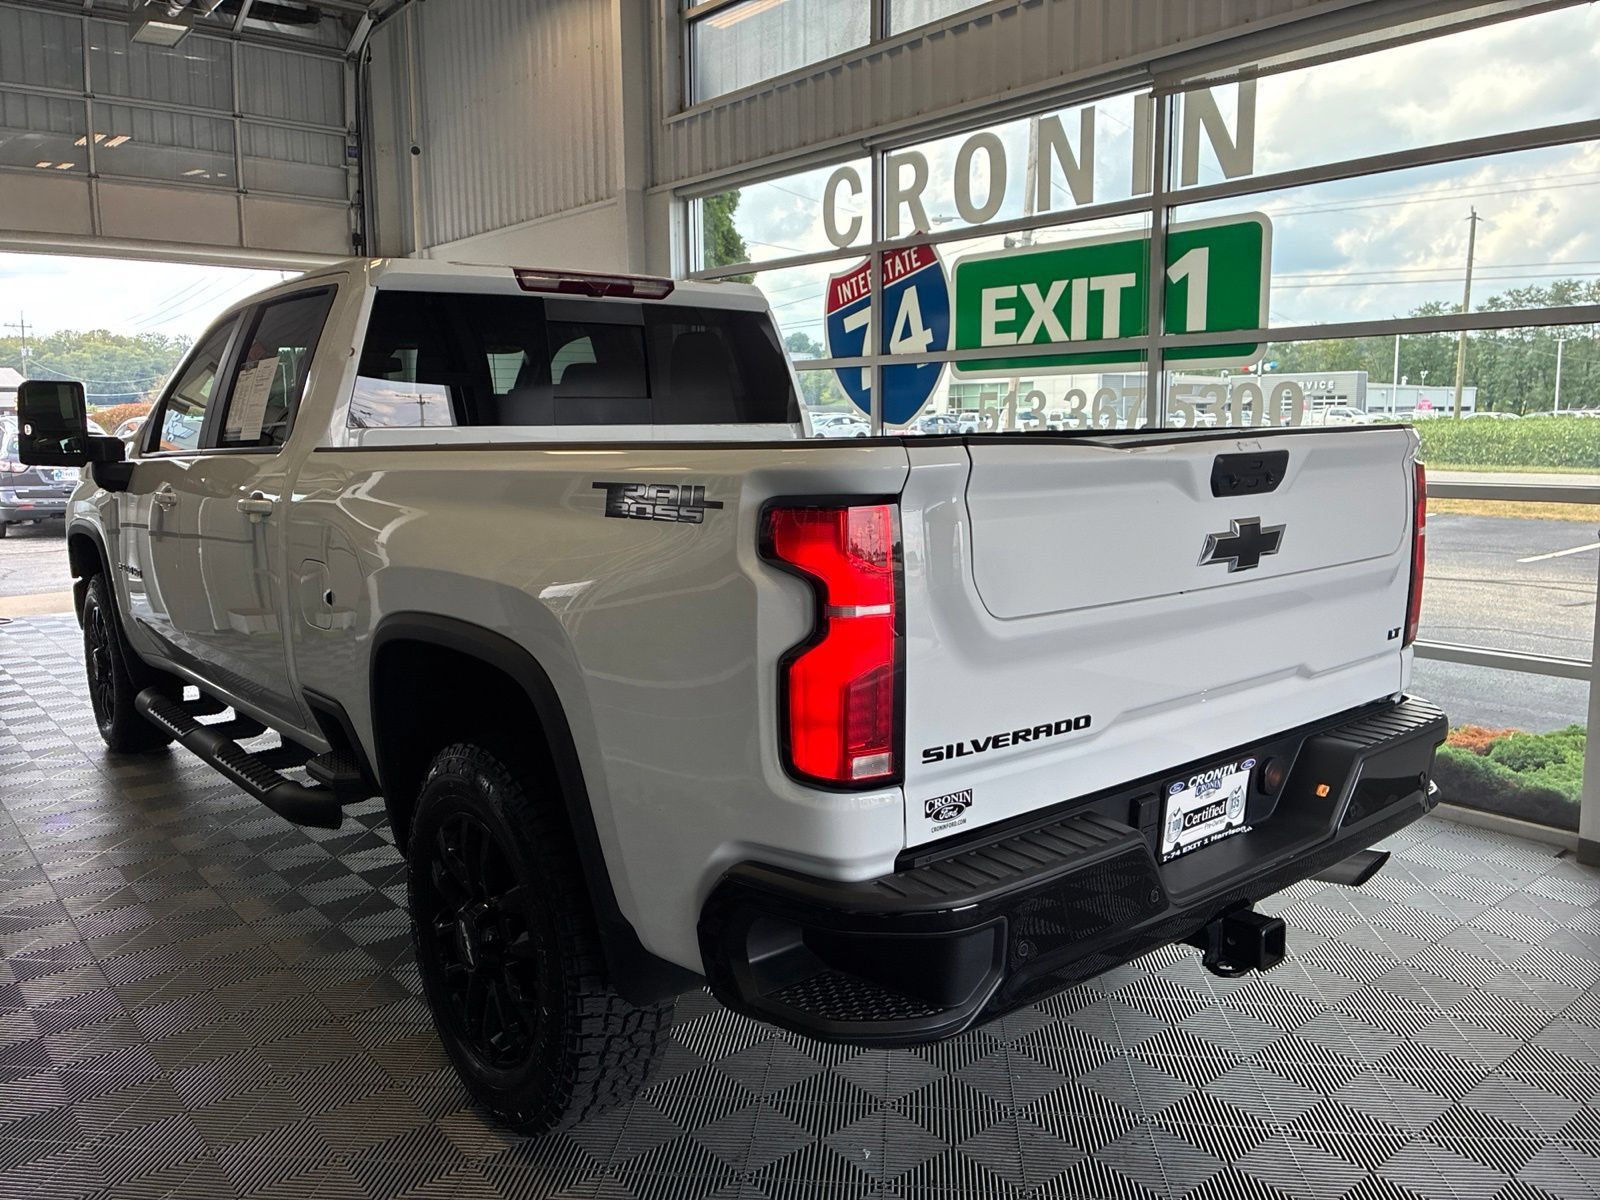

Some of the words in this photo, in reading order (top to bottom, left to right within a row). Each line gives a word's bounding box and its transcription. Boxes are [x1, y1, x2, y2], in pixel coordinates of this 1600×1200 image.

[823, 64, 1258, 248] CRONIN
[837, 246, 922, 305] INTETATE
[980, 272, 1137, 347] EXIT
[1166, 247, 1210, 332] 1
[843, 285, 934, 391] 74
[605, 502, 704, 524] BOSS
[1387, 626, 1402, 640] LT
[921, 714, 1092, 765] SILVERADO
[1188, 763, 1238, 788] CRONIN
[925, 790, 971, 814] CRONIN
[1184, 801, 1226, 827] Certified
[1163, 849, 1181, 862] I-74
[1182, 840, 1203, 853] EXIT
